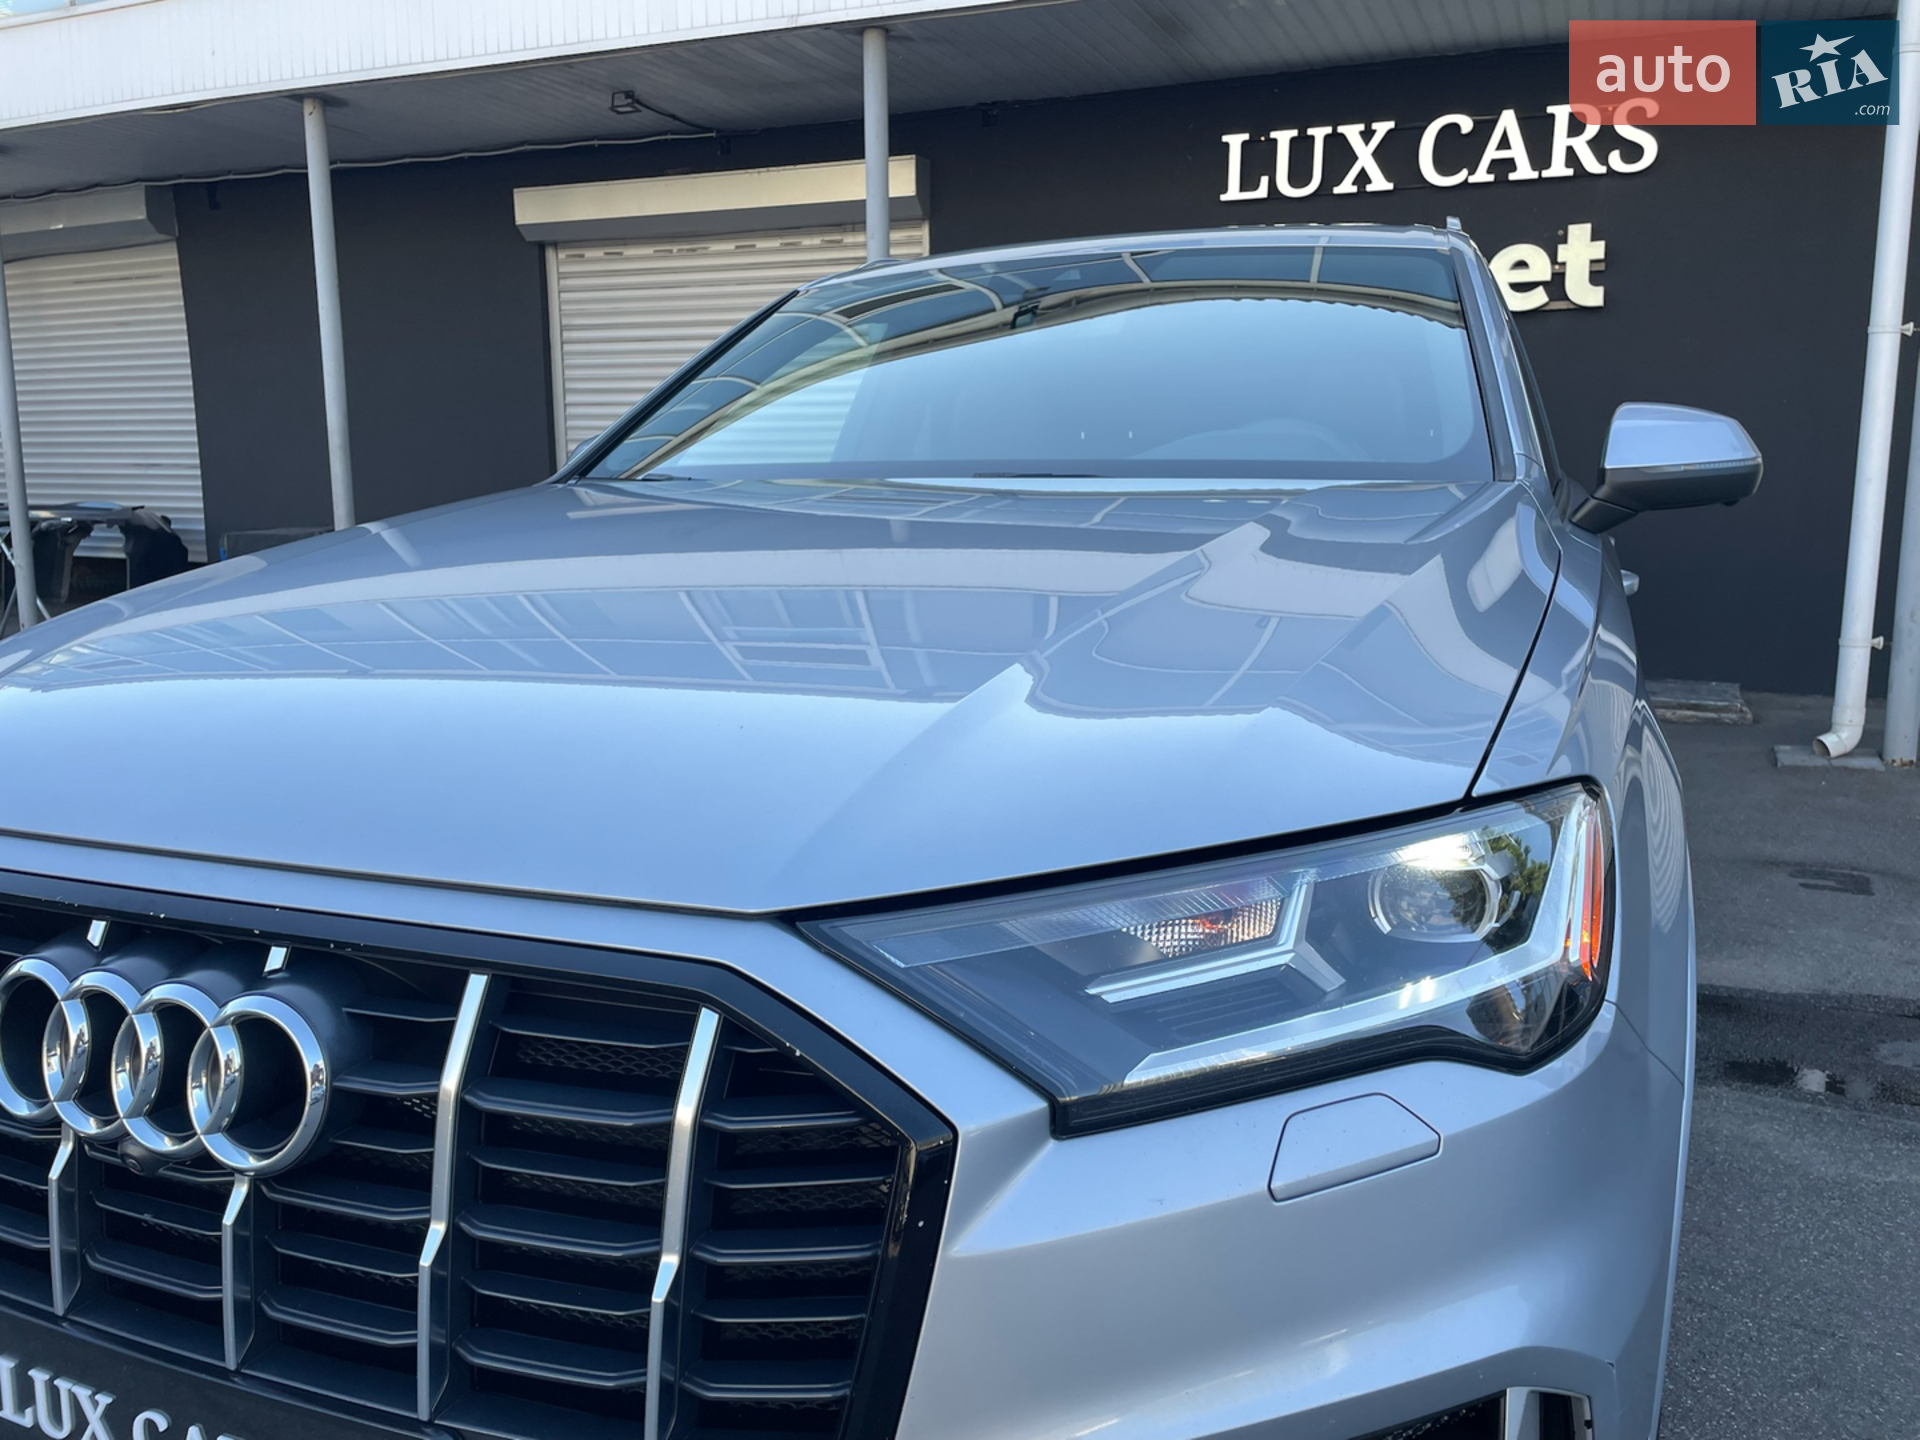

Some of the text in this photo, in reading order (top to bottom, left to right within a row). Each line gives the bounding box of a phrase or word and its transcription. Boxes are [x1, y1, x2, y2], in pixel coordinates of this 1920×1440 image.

[1219, 97, 1660, 202] LUX CARS
[0, 1355, 116, 1440] LUX
